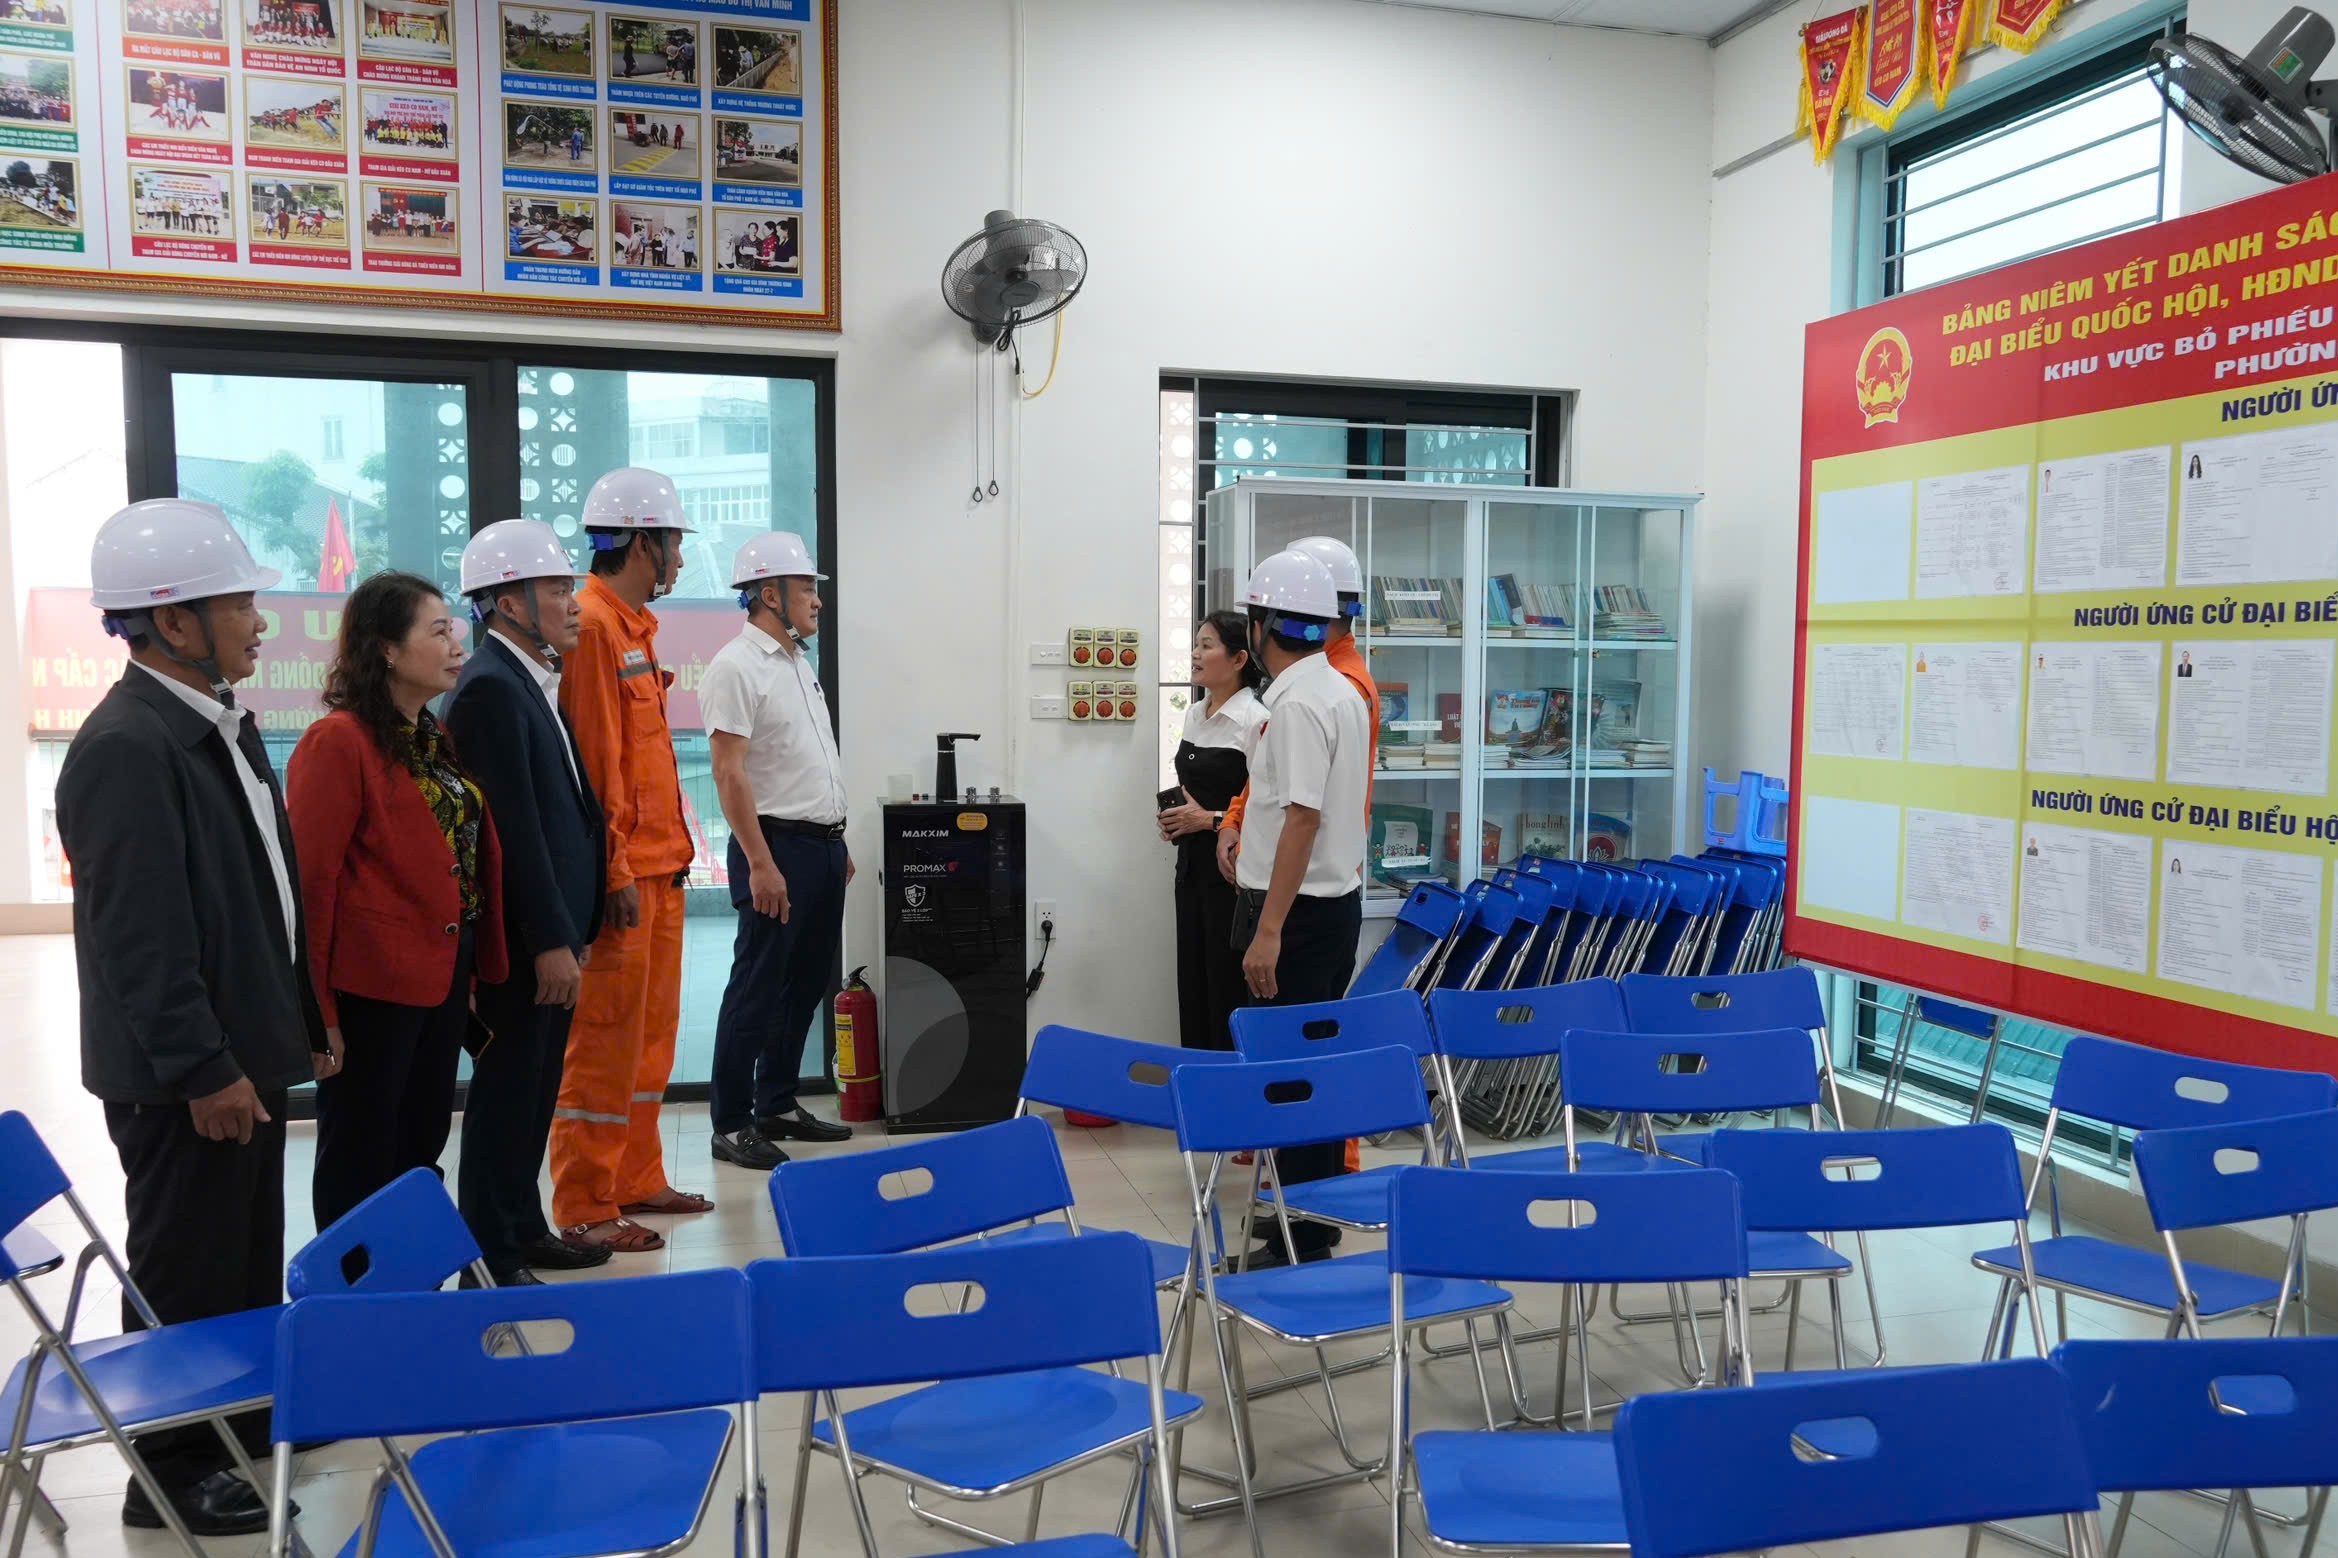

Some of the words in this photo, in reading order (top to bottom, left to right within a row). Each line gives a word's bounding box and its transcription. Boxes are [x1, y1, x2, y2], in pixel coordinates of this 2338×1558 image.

[772, 1, 793, 10] MINH
[1942, 300, 2012, 335] BẢNG
[2019, 277, 2093, 316] NIÊM
[2103, 257, 2159, 294] YẾT
[2168, 232, 2264, 279] DANH
[1950, 339, 1992, 367] ĐẠI
[2000, 316, 2063, 356] BIỂU
[2071, 297, 2152, 340] QUỐC
[2163, 282, 2229, 320] HỘI,
[2043, 356, 2099, 382] KHU
[2107, 342, 2165, 369] VỰC
[2174, 326, 2217, 357] BỎ
[2228, 305, 2333, 345] PHIẾU
[2215, 340, 2338, 379] PHƯỜN
[2221, 387, 2302, 422] NGƯỜI
[2074, 602, 2139, 627] NGƯỜI
[2146, 601, 2194, 625] ỨNG
[2202, 596, 2238, 624] CỬ
[2241, 602, 2285, 628] ĐẠI
[2032, 789, 2092, 813] NGƯỜI
[2100, 793, 2143, 819] ỨNG
[2151, 797, 2184, 822] CỬ
[2189, 805, 2229, 831] ĐẠI
[2238, 805, 2297, 836] BIỂU
[902, 830, 949, 838] MAKXIM
[903, 864, 946, 873] PROMAX
